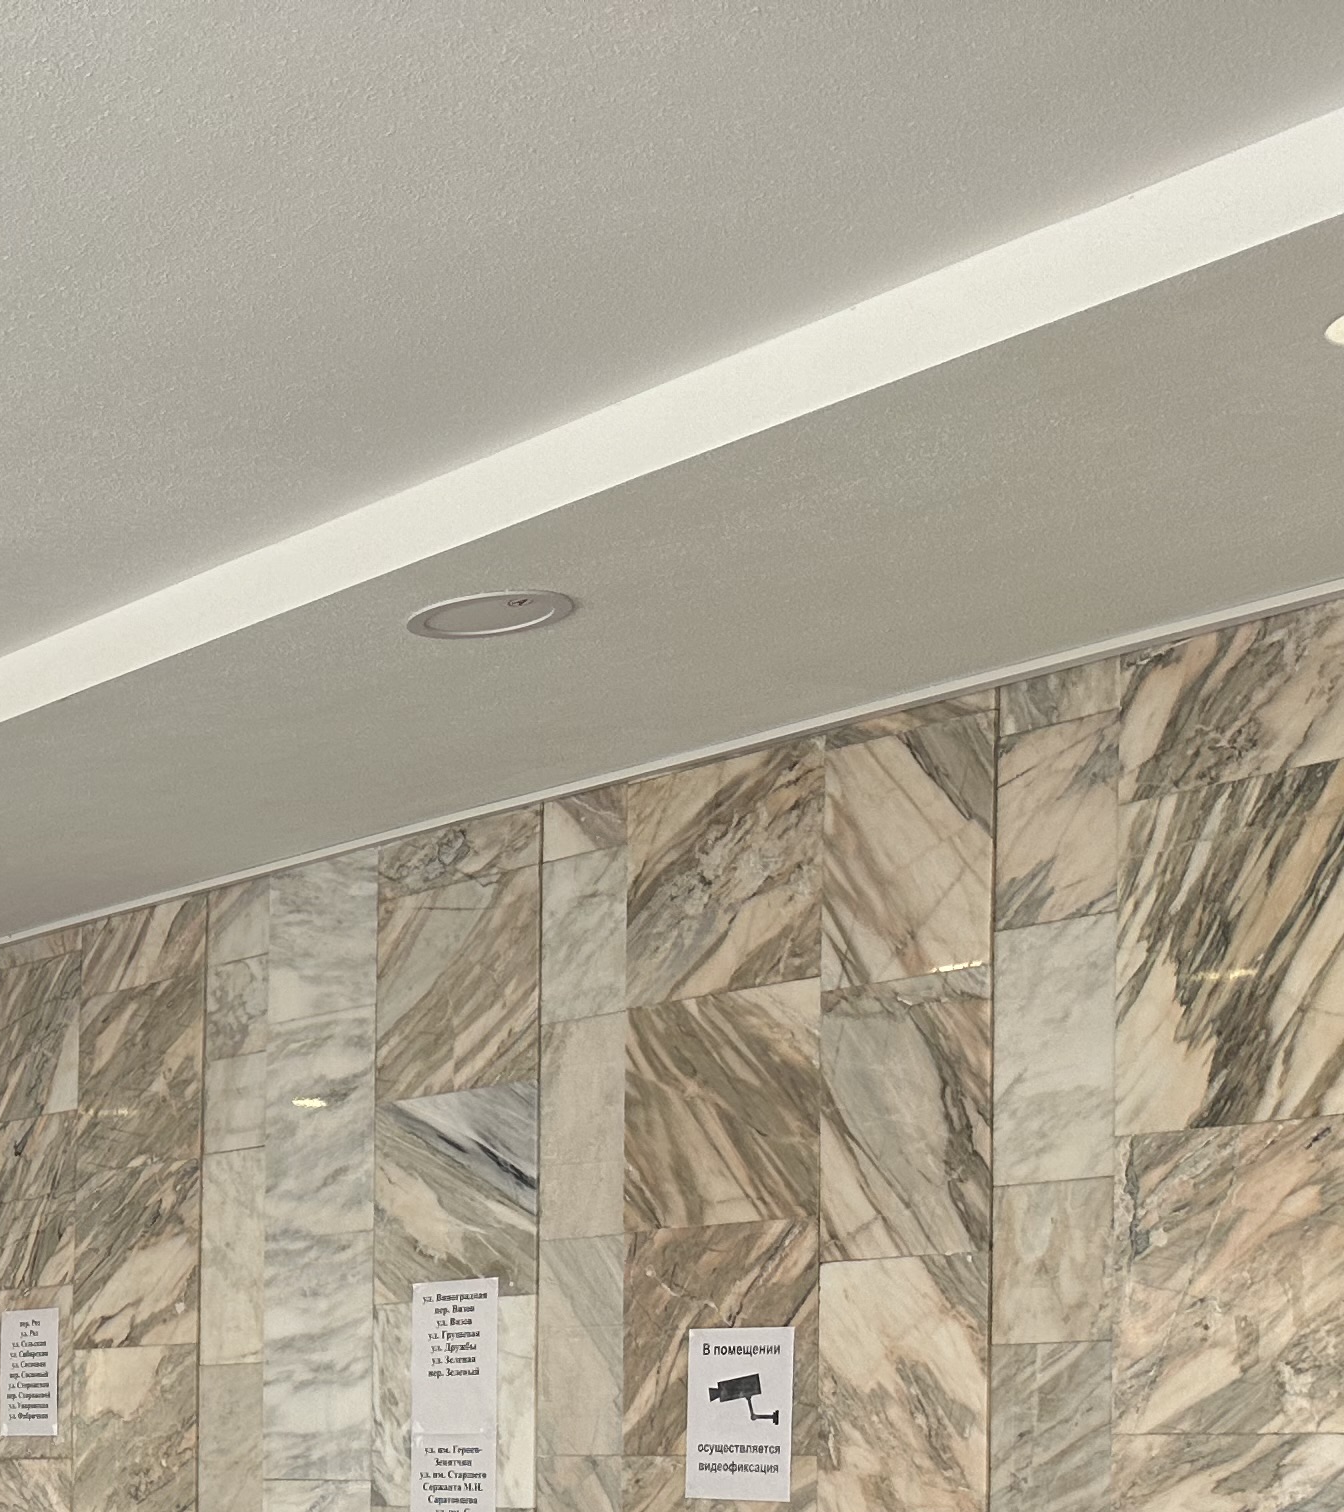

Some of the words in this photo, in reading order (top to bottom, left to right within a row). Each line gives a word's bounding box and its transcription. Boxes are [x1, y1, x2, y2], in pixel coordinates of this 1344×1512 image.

[703, 1343, 711, 1356] В
[714, 1344, 781, 1357] помещении
[697, 1443, 781, 1455] осуществляется
[698, 1461, 779, 1475] видеофиксация
